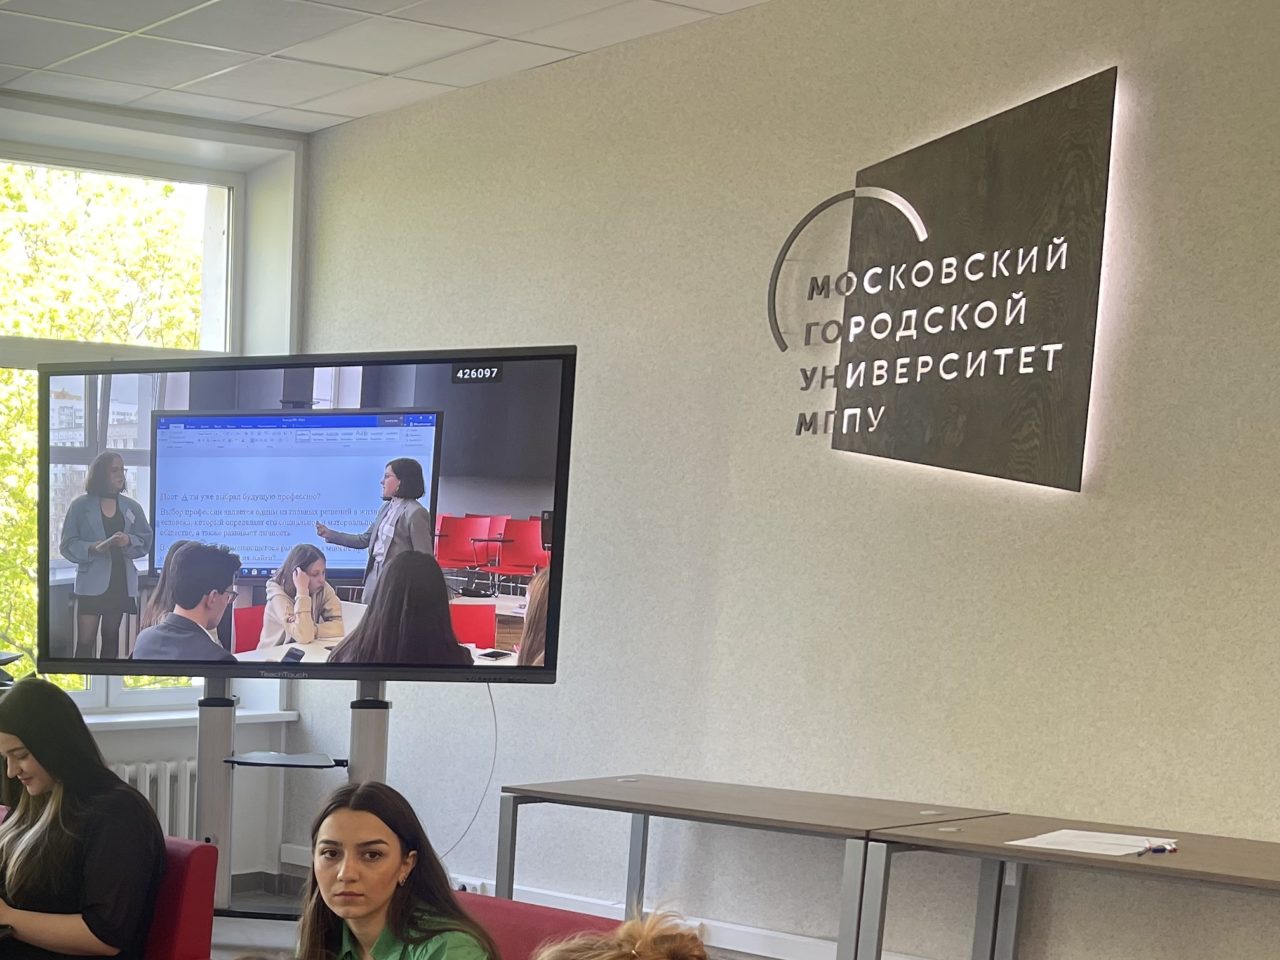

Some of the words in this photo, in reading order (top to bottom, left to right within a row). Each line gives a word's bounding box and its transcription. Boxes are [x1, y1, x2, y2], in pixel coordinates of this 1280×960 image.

[807, 236, 1069, 300] МОСКОВСКИЙ
[804, 291, 1026, 346] ГОРОДСКОЙ
[456, 368, 498, 379] 426097
[799, 343, 1063, 391] УНИВЕРСИТЕТ
[795, 406, 885, 436] МГПУ
